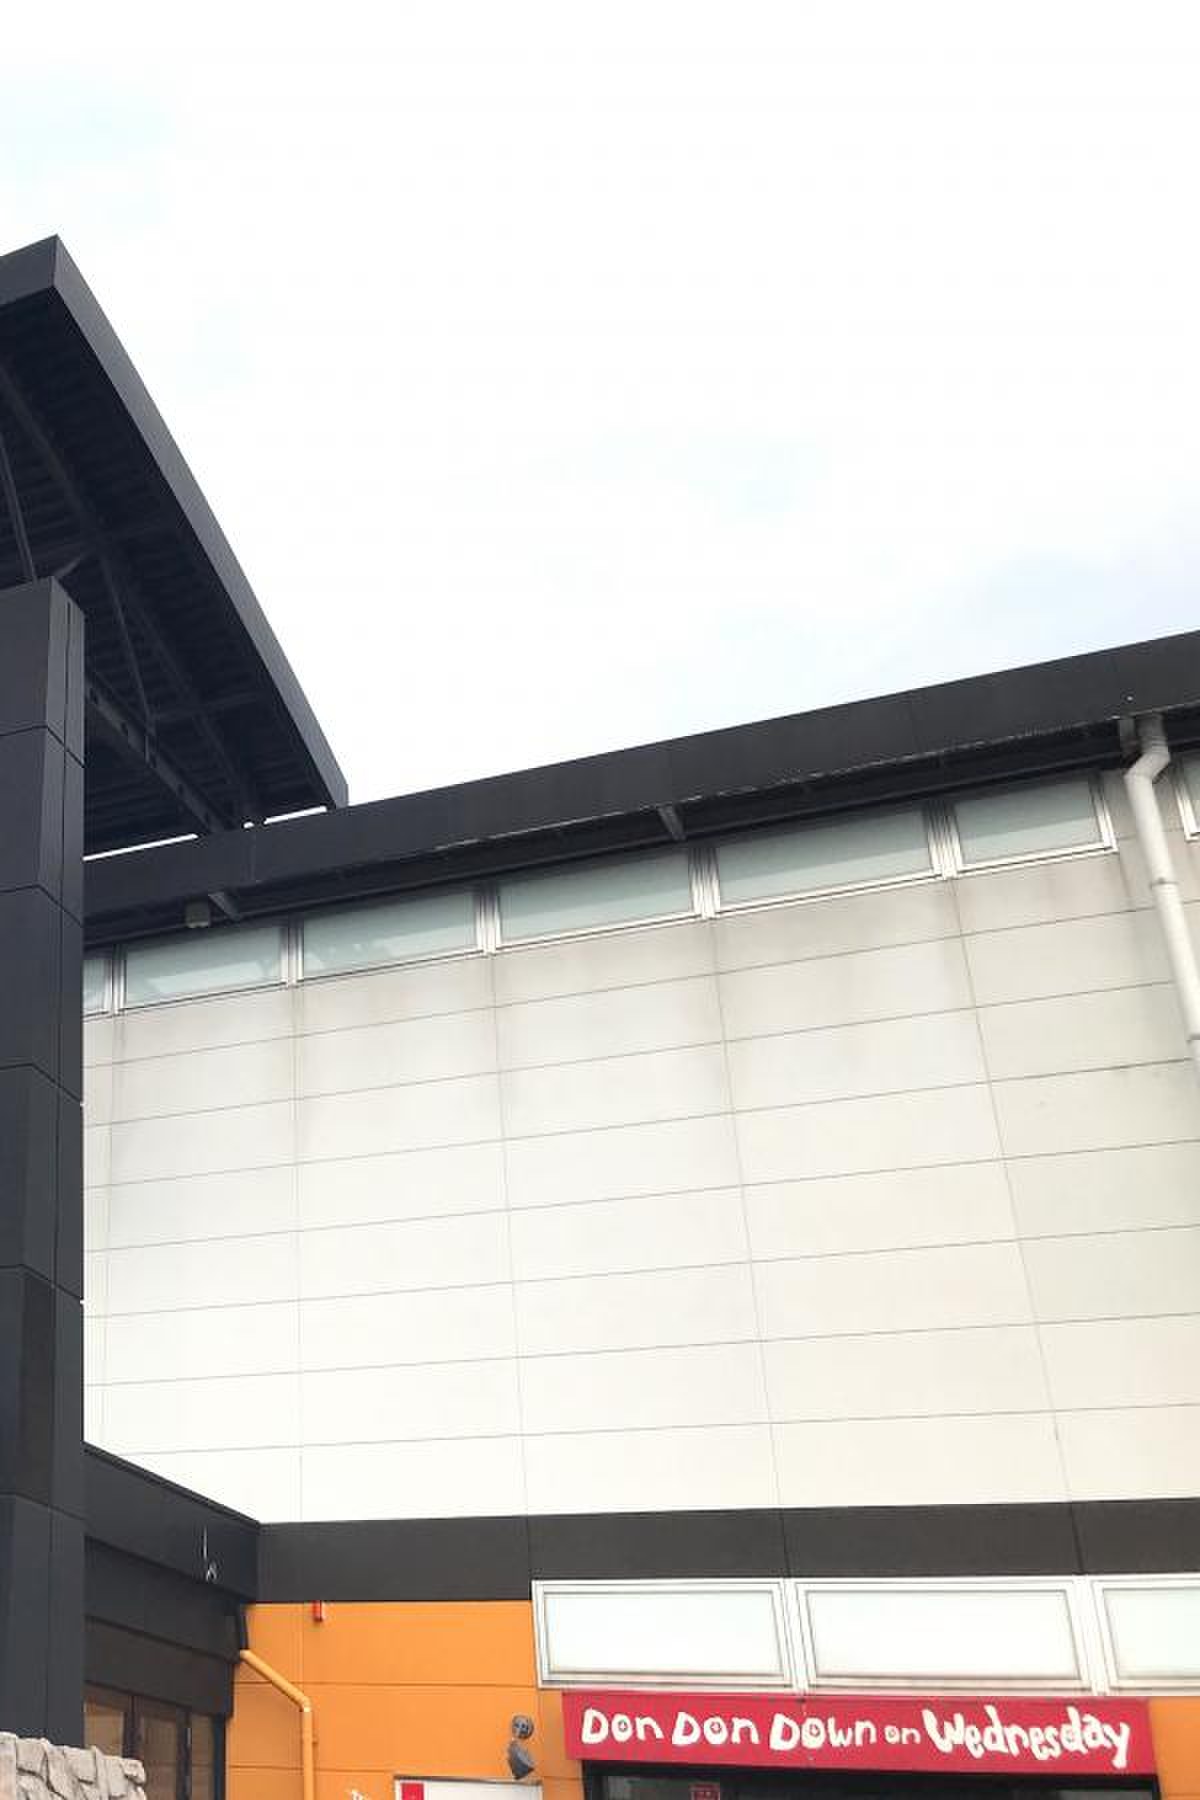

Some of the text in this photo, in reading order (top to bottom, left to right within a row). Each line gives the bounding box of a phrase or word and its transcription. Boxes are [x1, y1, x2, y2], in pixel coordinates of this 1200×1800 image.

[581, 1707, 664, 1744] Don
[671, 1711, 760, 1745] Don
[885, 1725, 921, 1744] on
[921, 1704, 1130, 1769] Wednesday
